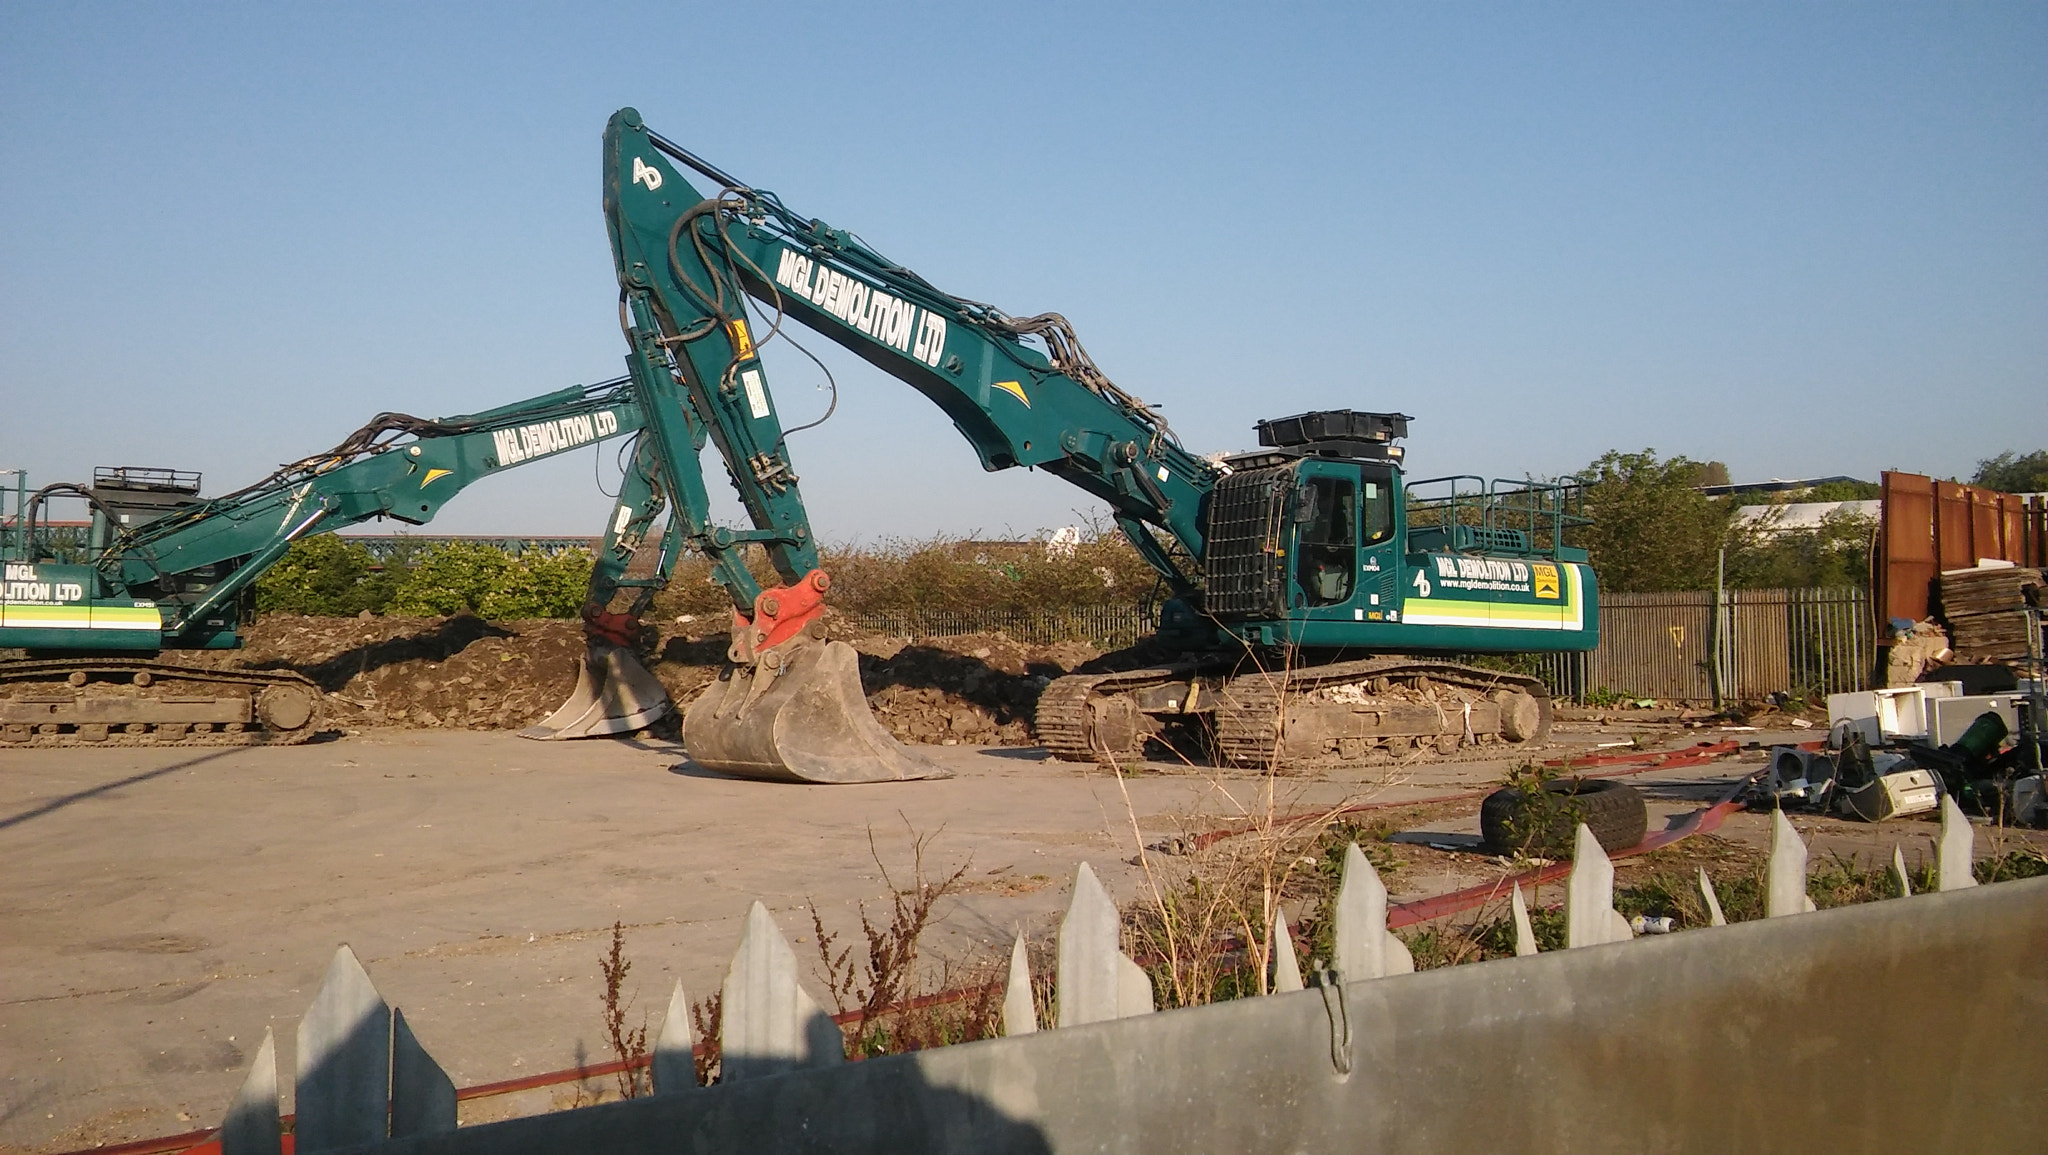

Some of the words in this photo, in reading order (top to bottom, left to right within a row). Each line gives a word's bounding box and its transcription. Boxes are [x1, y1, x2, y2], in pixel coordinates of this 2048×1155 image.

[776, 248, 814, 300] MGL
[811, 265, 917, 353] DEMOLITION
[912, 308, 947, 368] LTD
[493, 428, 525, 467] MGL
[520, 415, 595, 460] DEMOLITION
[593, 410, 618, 438] LTD
[5, 565, 37, 581] MGL
[1436, 557, 1458, 578] MGL
[1457, 558, 1512, 581] DEMOLITION
[1512, 562, 1529, 582] LTD
[1535, 566, 1556, 578] MGL
[55, 583, 82, 601] LTD
[1440, 579, 1531, 592] www.mgldemolition.co.uk
